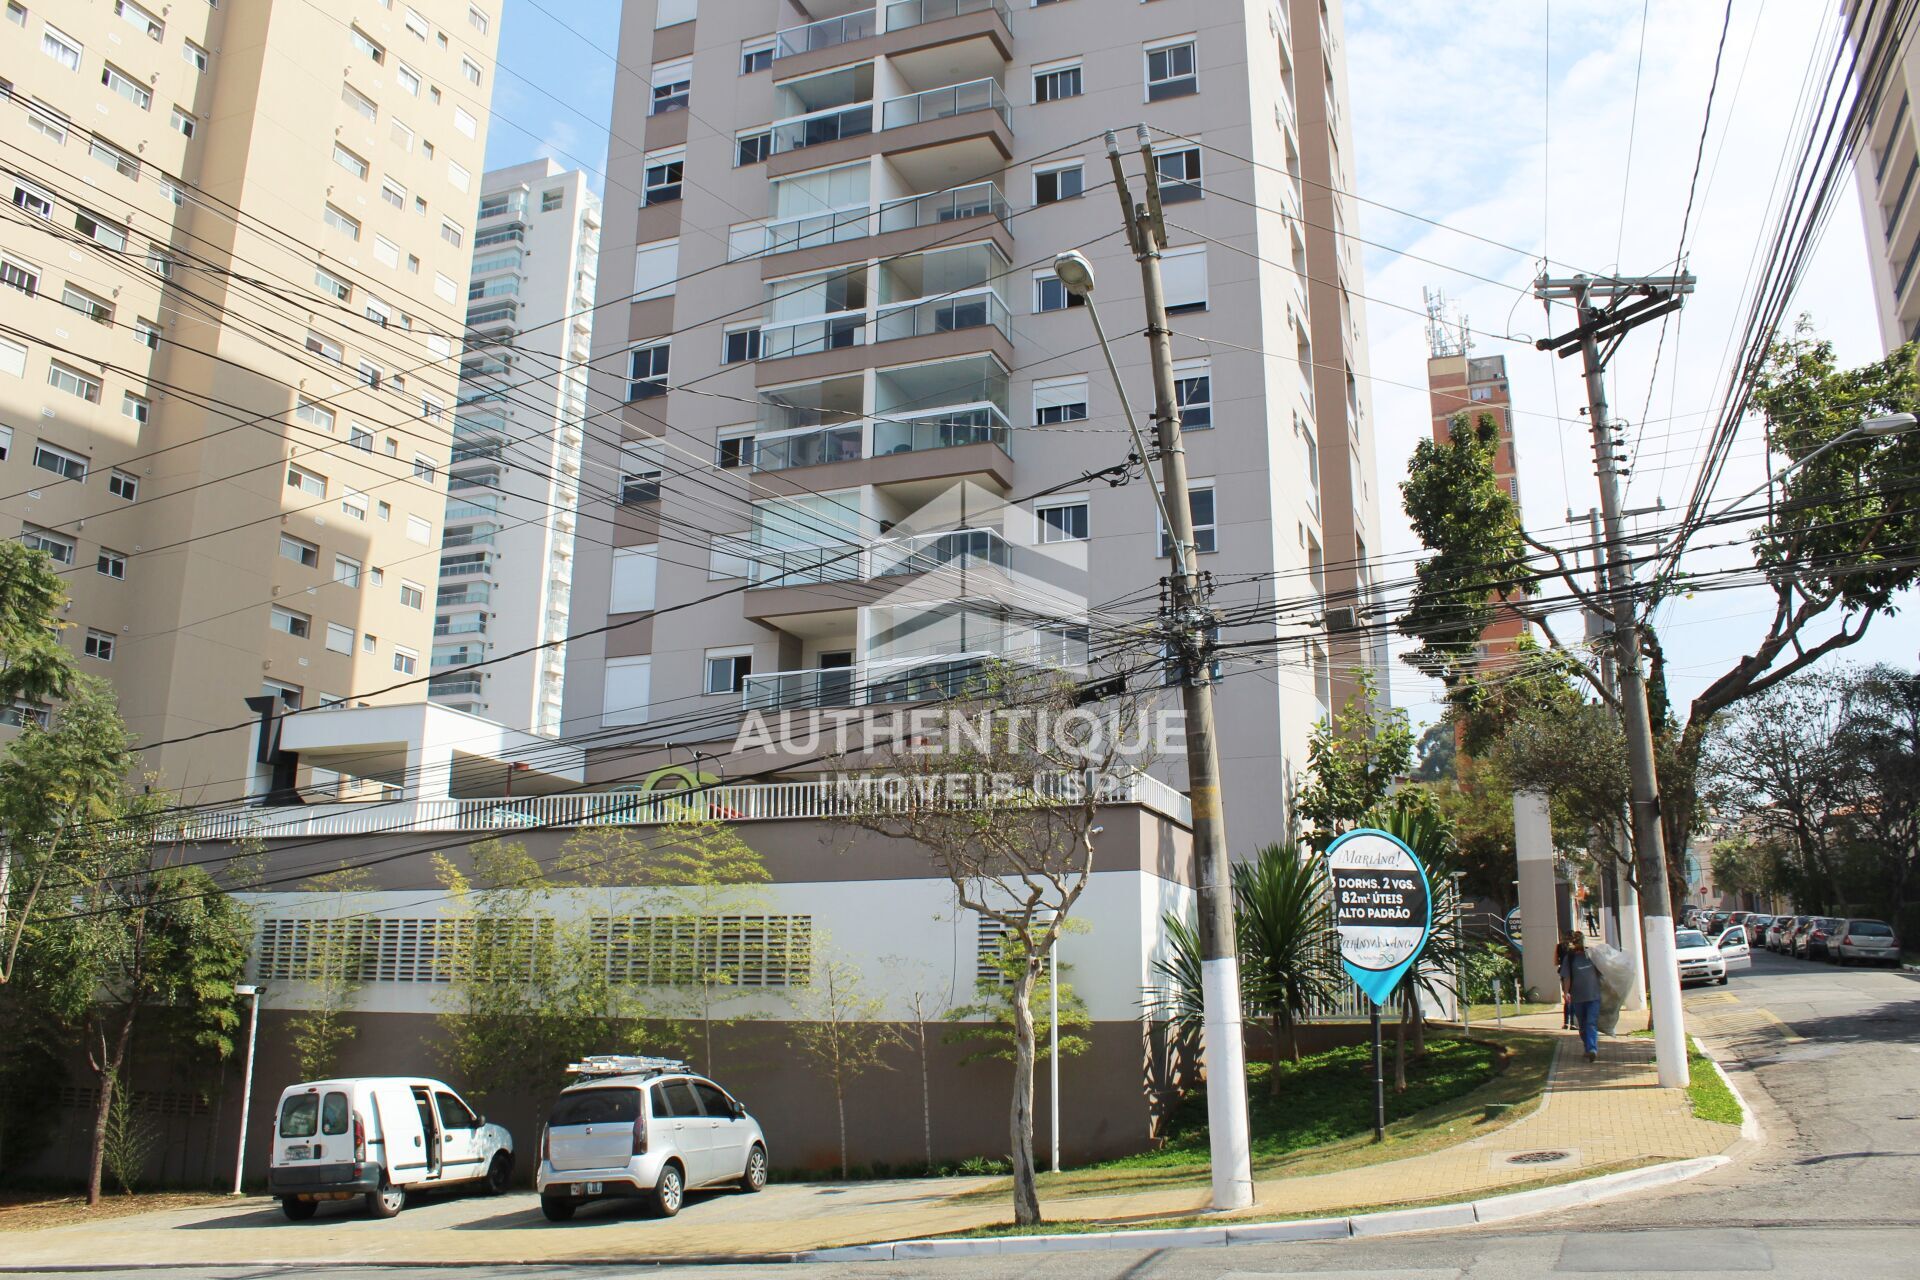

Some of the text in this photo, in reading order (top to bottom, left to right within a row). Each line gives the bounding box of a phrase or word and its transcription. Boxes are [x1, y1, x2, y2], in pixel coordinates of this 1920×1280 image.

[1338, 877, 1381, 890] DORMS.
[1382, 877, 1390, 889] 2
[1391, 879, 1416, 890] VGS.
[1372, 891, 1404, 904] ÚTEIS
[1338, 906, 1411, 919] ALTO PADRÃO
